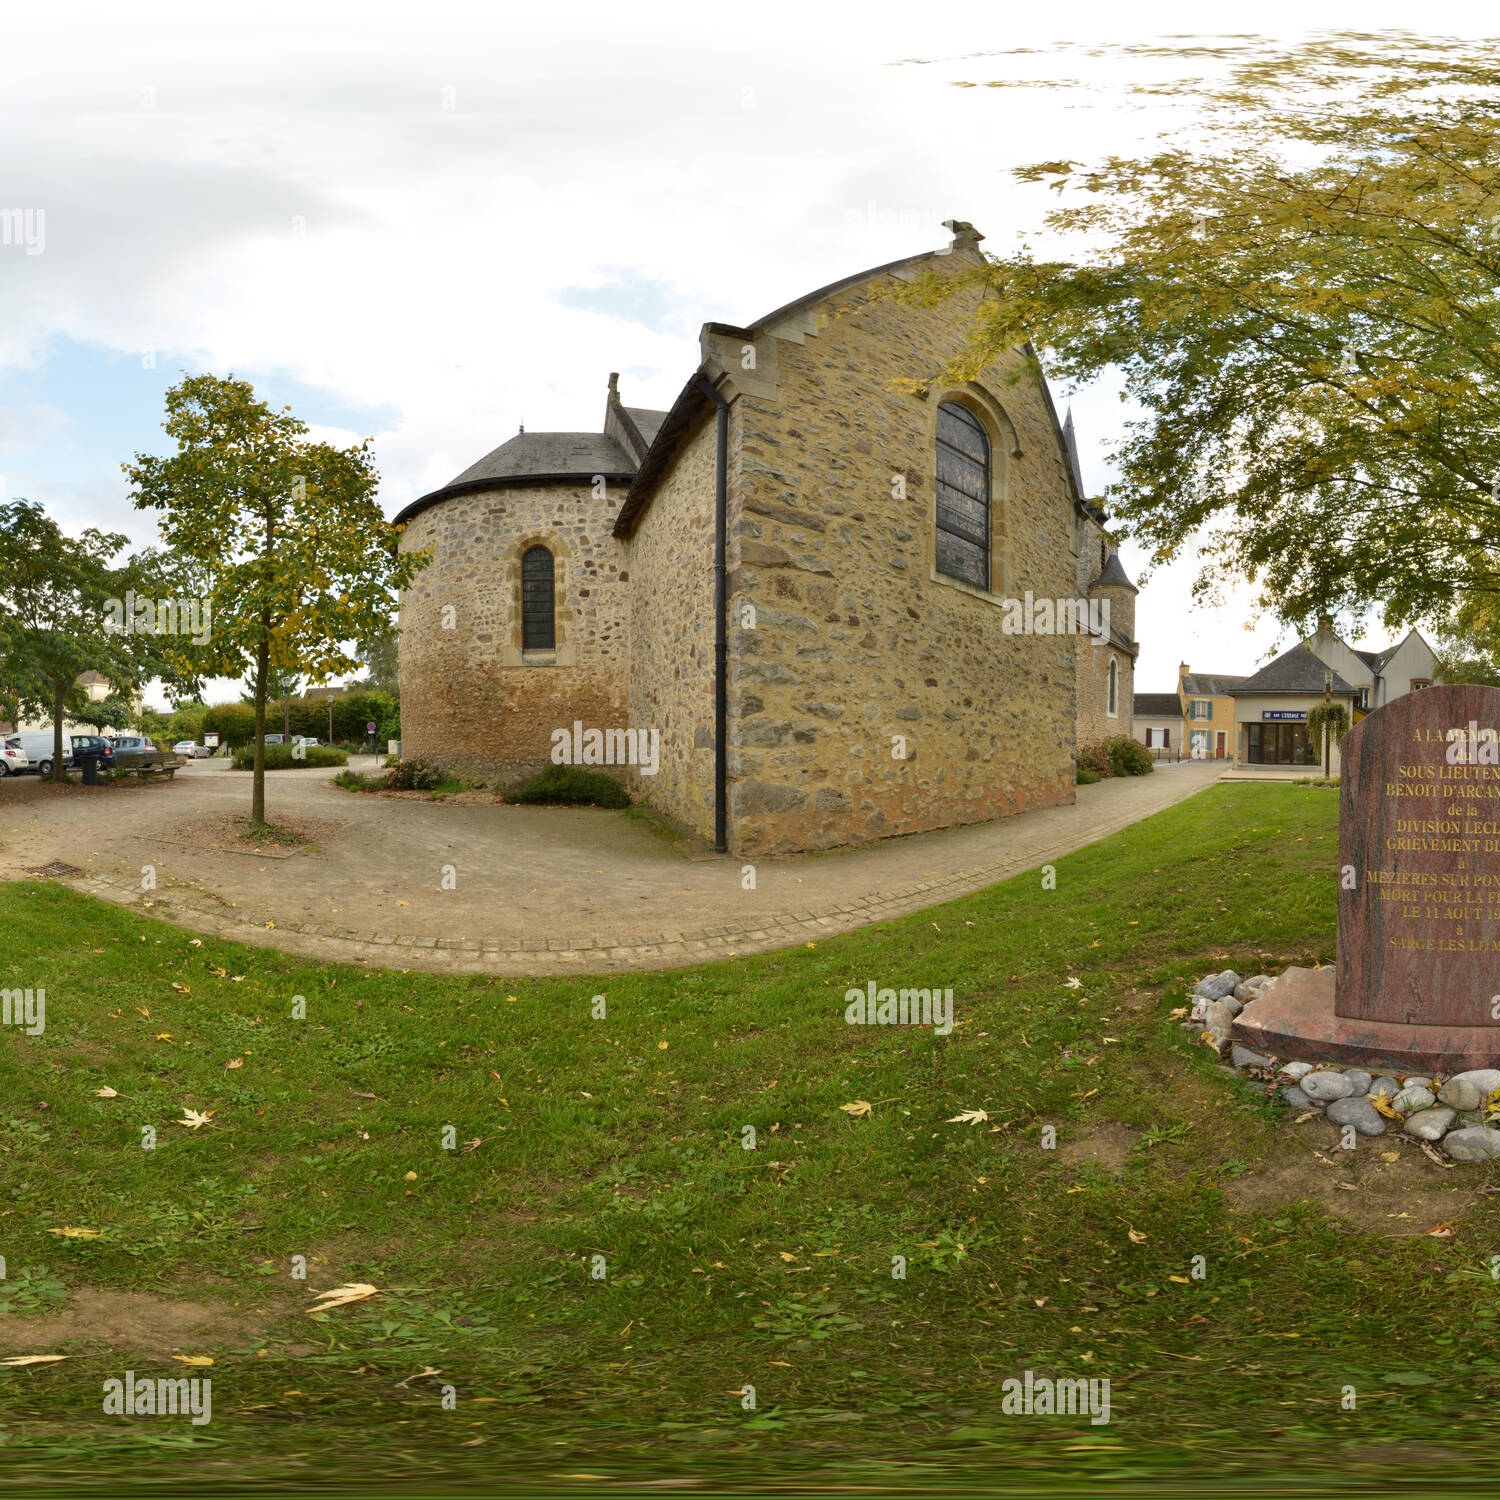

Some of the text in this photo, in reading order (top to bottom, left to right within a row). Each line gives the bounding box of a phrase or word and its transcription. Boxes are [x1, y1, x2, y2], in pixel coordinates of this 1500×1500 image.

[1412, 728, 1422, 742] A
[1426, 728, 1444, 742] LA
[1456, 748, 1472, 761] du
[1399, 765, 1435, 779] SOUS
[1385, 783, 1440, 797] BENOIT
[1447, 804, 1478, 817] de la
[1397, 819, 1461, 834] DIVISION
[1387, 835, 1481, 852] GRIÈVEMENT
[1441, 873, 1469, 887] SUR
[1380, 888, 1419, 902] MORT
[1424, 891, 1463, 903] POUR
[1466, 892, 1484, 904] LA
[1403, 906, 1421, 918] LE
[1425, 907, 1439, 919] 11
[1443, 908, 1482, 920] AOUT
[1456, 924, 1464, 936] à
[1440, 939, 1465, 951] LES
[1470, 939, 1487, 951] LE
